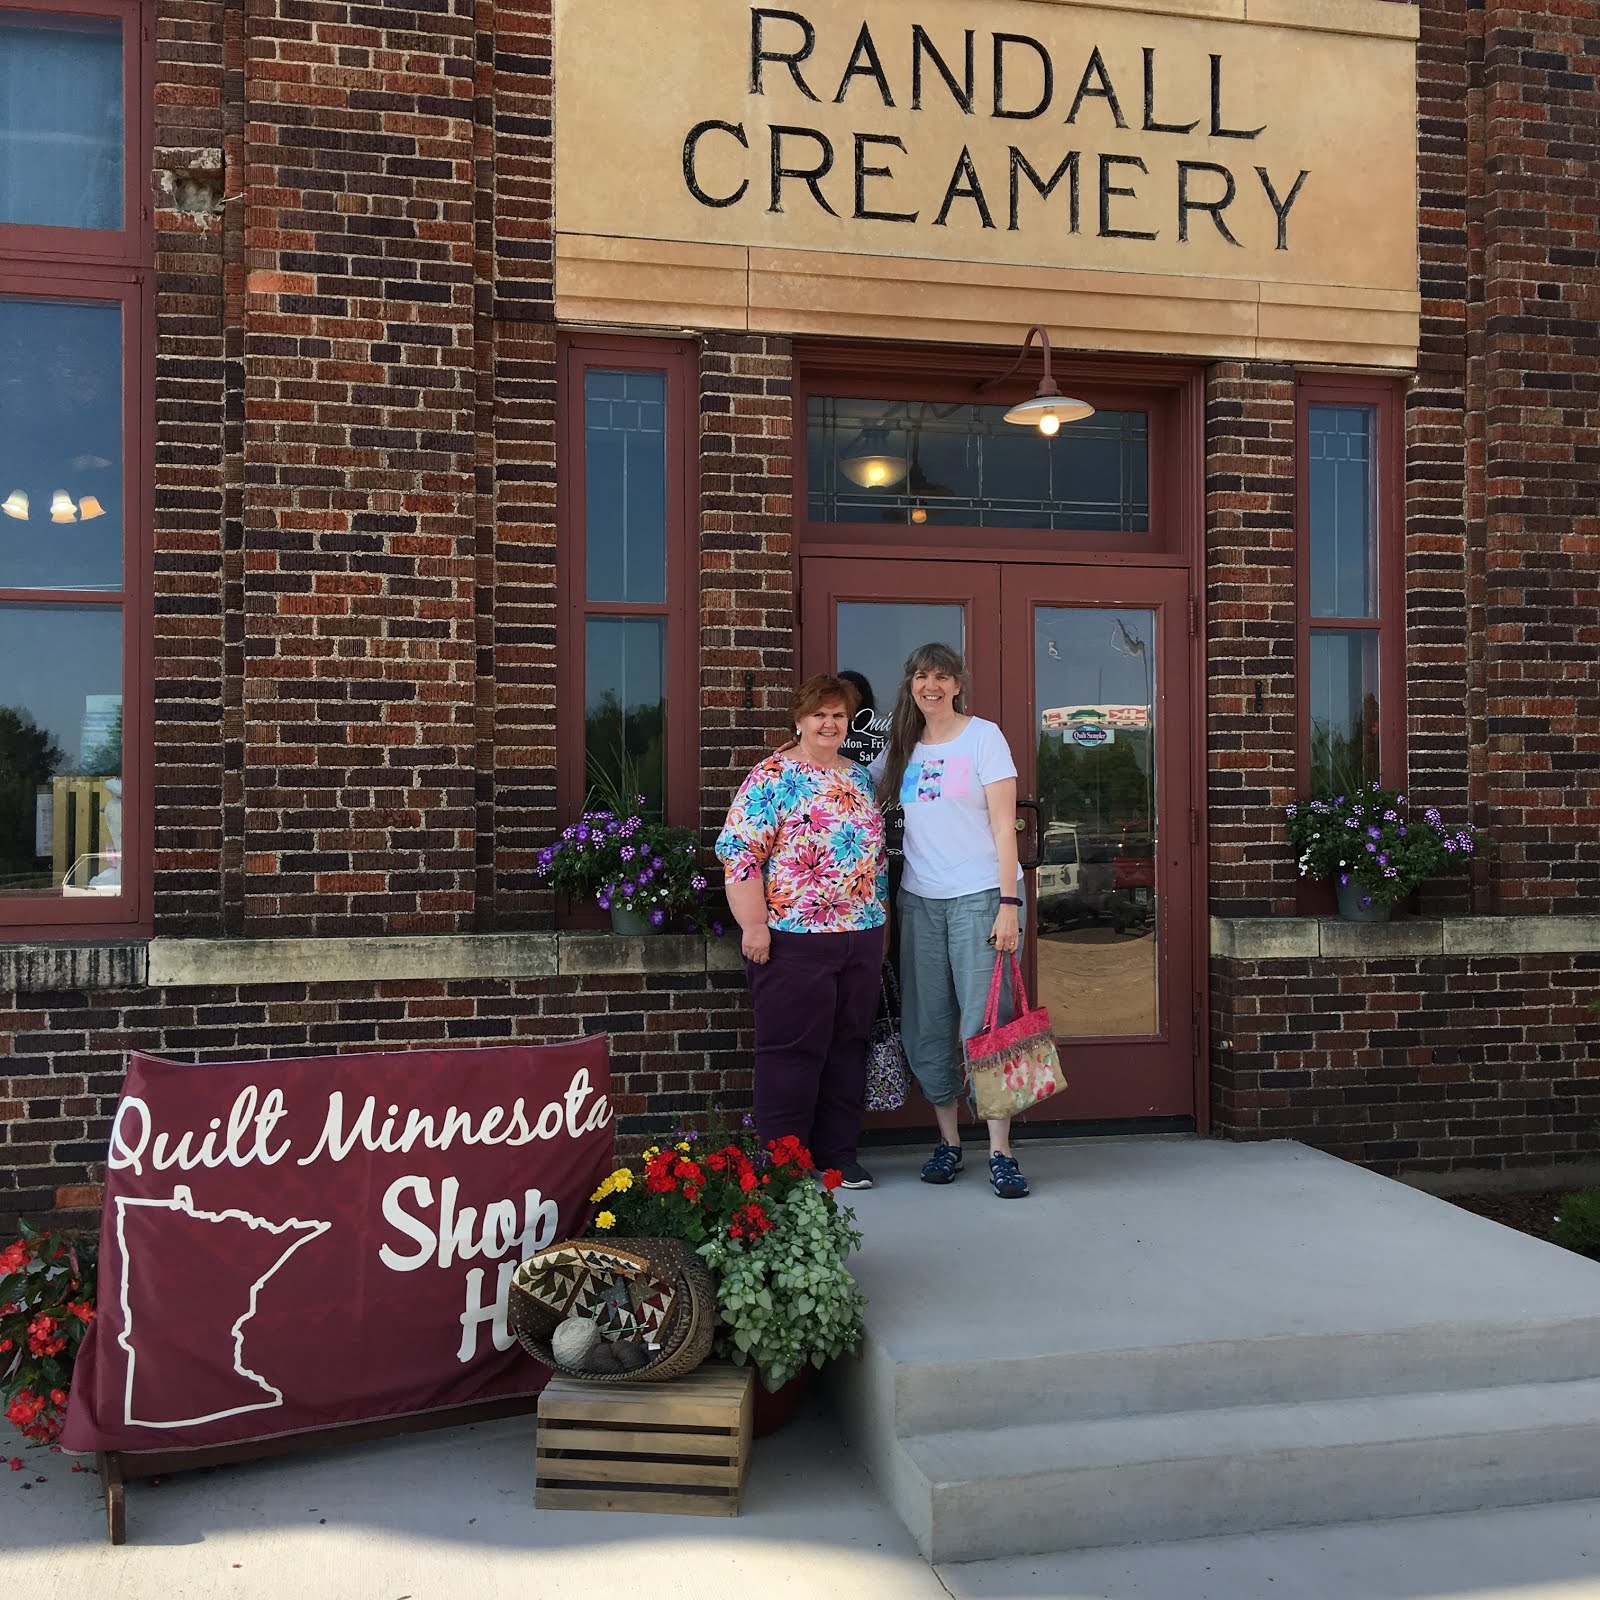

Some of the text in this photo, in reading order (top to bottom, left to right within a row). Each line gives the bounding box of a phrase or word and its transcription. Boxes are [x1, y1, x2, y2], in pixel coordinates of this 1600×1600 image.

[749, 8, 1267, 140] RANDALL
[682, 119, 1311, 250] CREAMERY
[859, 751, 875, 762] Sat
[871, 738, 885, 749] Fri
[1073, 731, 1106, 741] Quilt Sampler
[108, 1067, 614, 1175] Quilt Minnesota
[379, 1175, 559, 1272] Shop
